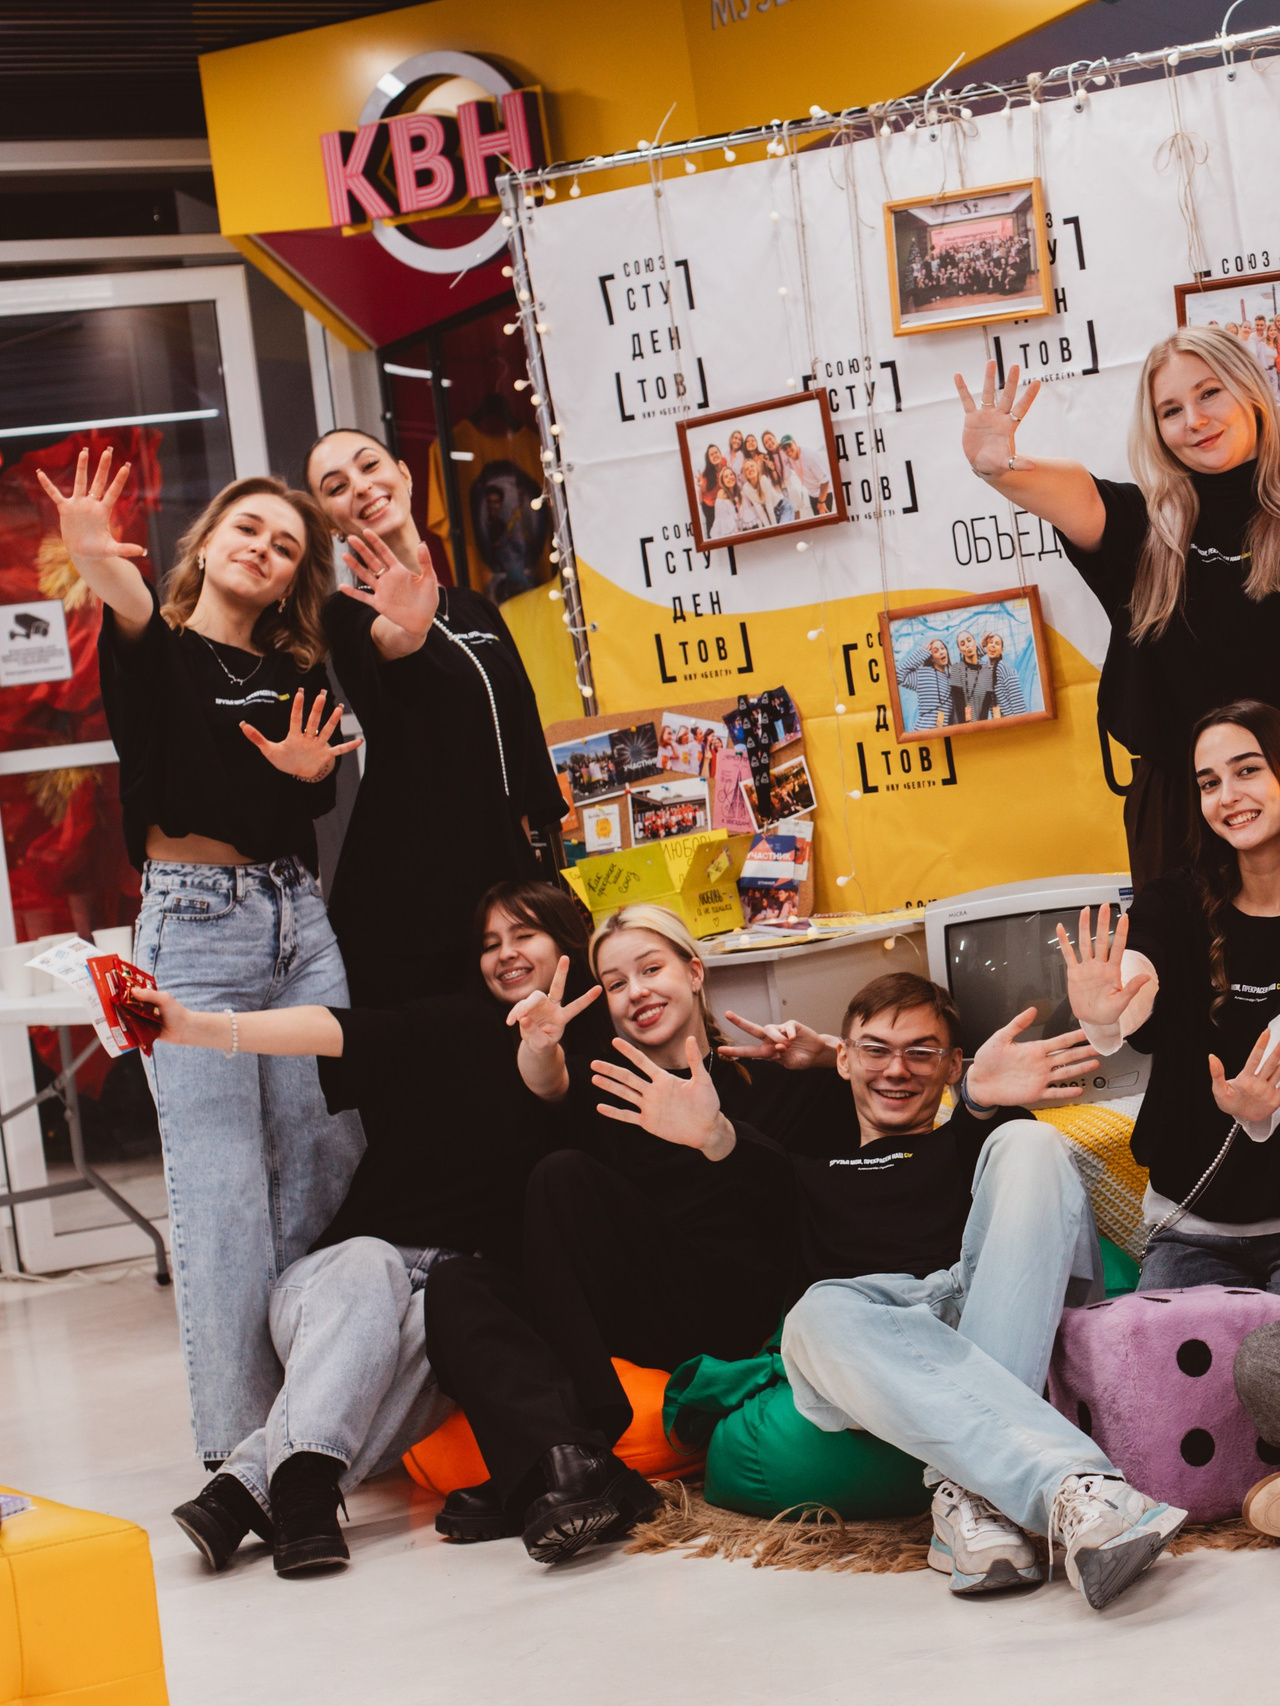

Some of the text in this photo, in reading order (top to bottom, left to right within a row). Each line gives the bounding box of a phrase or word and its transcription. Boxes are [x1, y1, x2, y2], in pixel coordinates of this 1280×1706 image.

[320, 90, 533, 227] КВН
[623, 255, 666, 277] СОЮЗ
[1222, 251, 1270, 275] СОЮЗ
[626, 280, 671, 311] СТУ
[631, 326, 681, 361] ДЕН
[1019, 336, 1072, 369] ТОВ
[825, 356, 872, 378] СОЮЗ
[637, 373, 687, 403] ТОВ
[828, 382, 876, 413] СТУ
[835, 428, 886, 463] ДЕН
[842, 476, 892, 506] ТОВ
[672, 591, 722, 623] ДЕН
[679, 636, 728, 666] ТОВ
[881, 746, 932, 776] ТОВ
